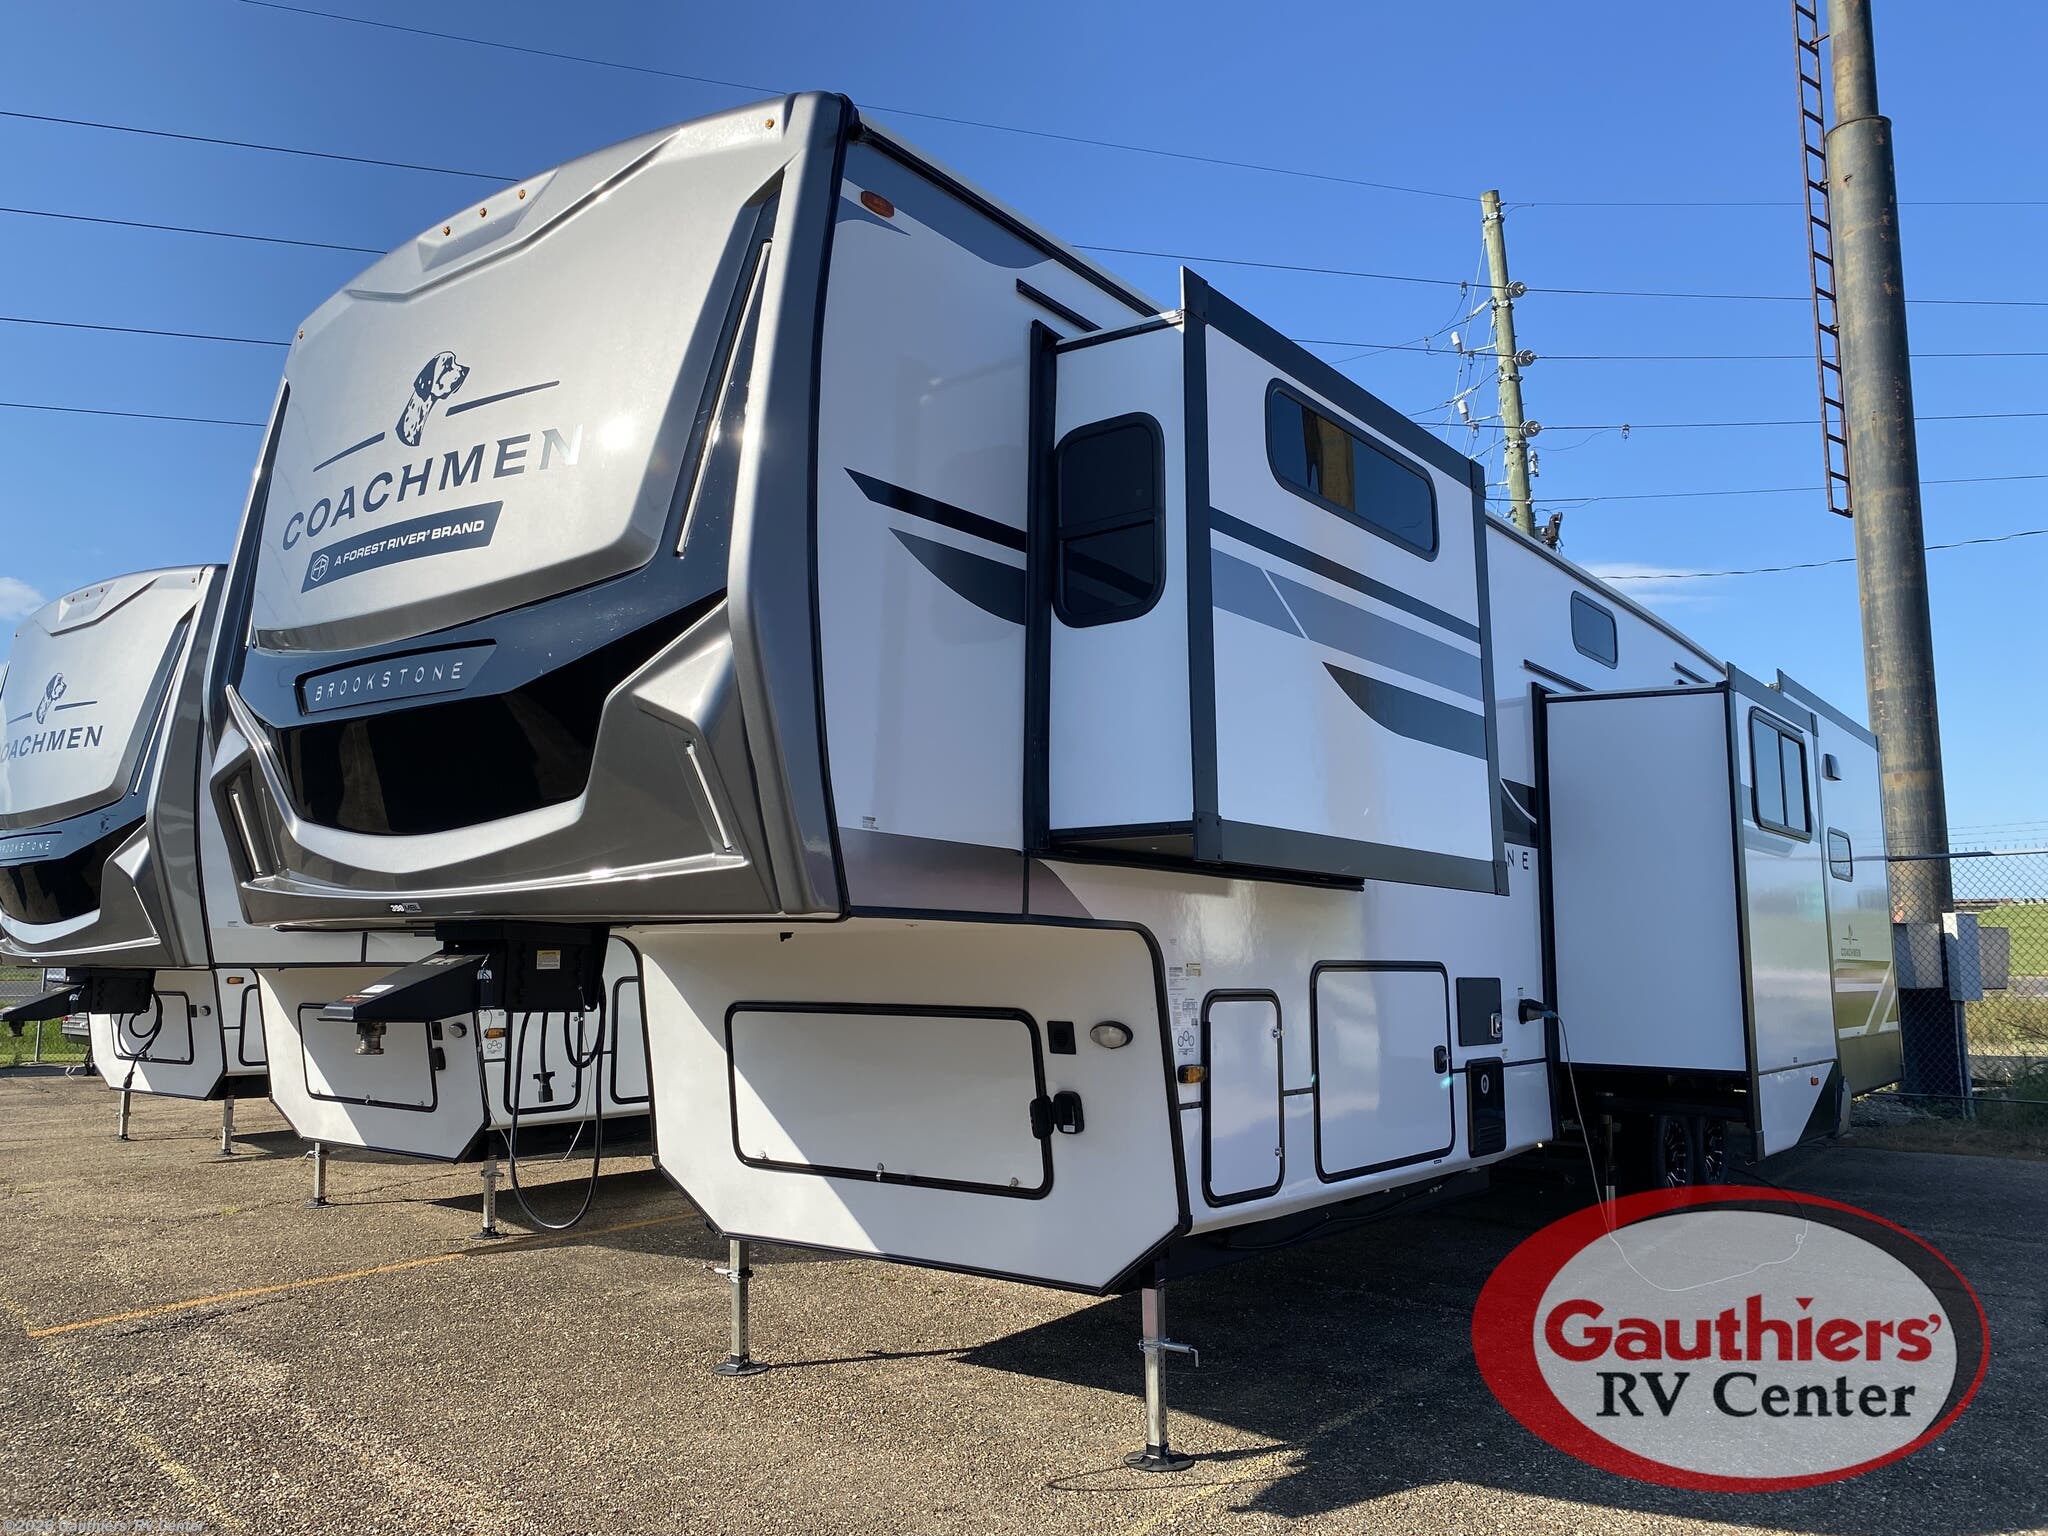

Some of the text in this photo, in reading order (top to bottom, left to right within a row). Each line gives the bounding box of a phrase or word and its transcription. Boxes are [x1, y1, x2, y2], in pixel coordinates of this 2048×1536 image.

[282, 424, 583, 551] COACHMEN
[333, 554, 342, 567] A
[342, 541, 387, 563] FOREST
[431, 519, 485, 540] BRAND
[315, 662, 463, 702] BROOKSTONE
[0, 725, 103, 763] OACHMEN
